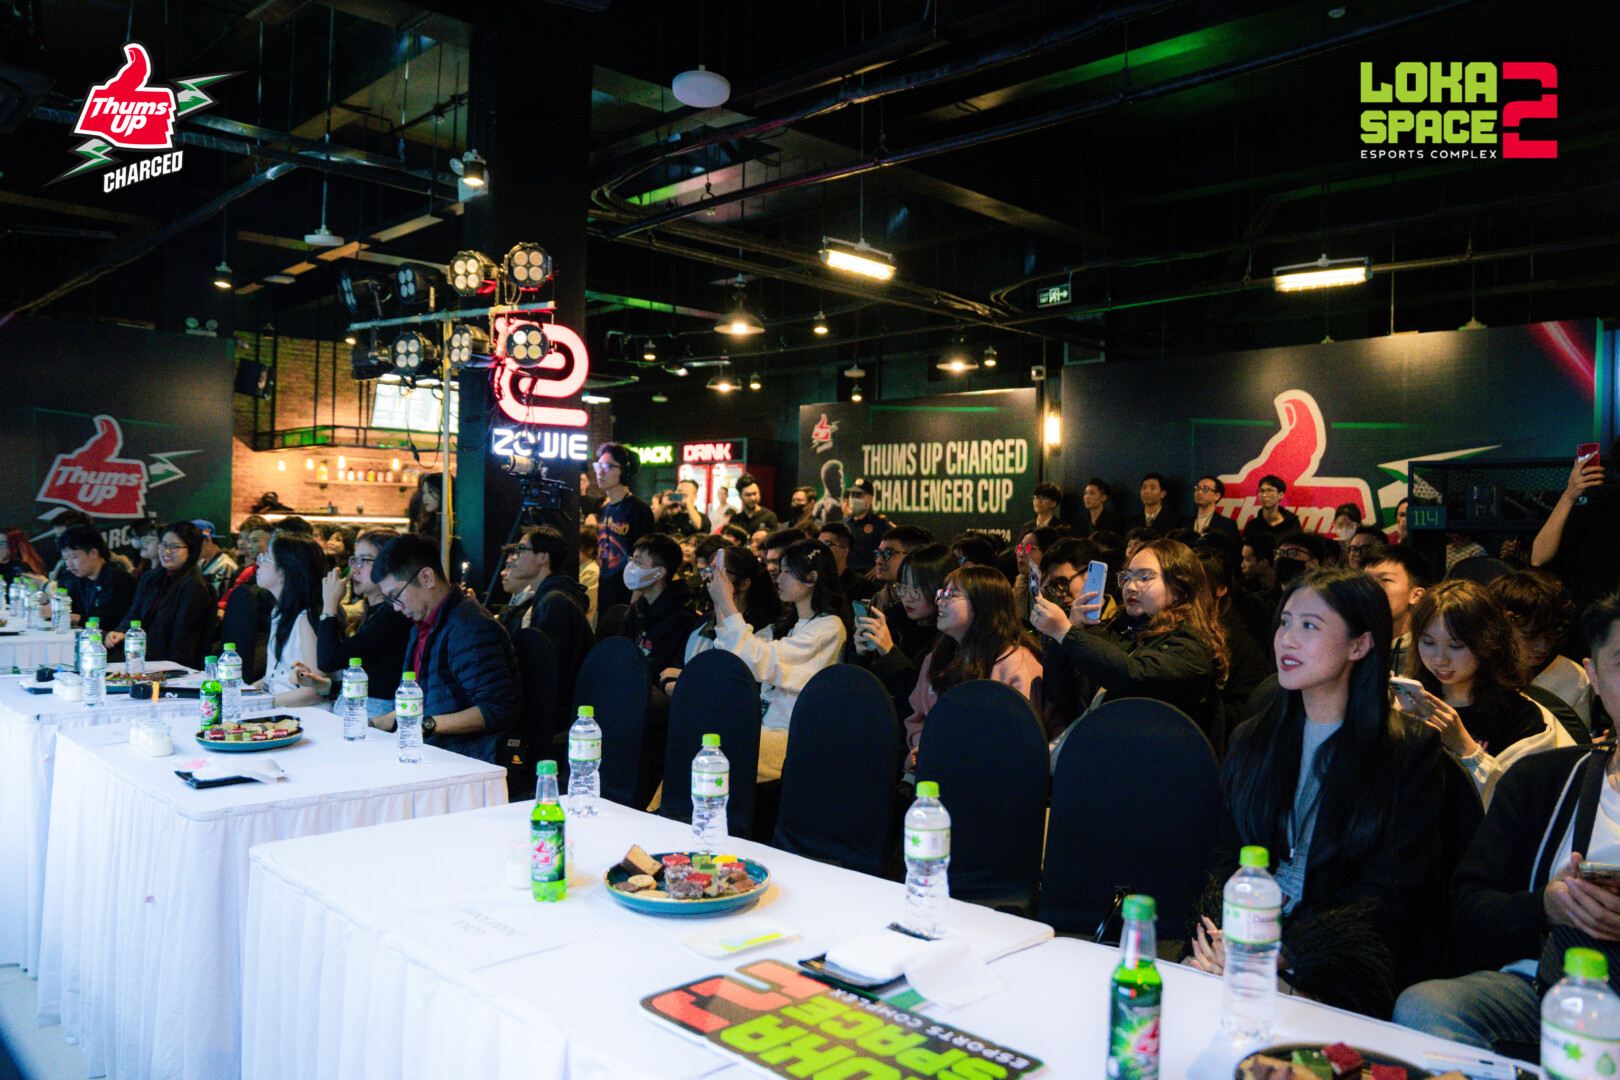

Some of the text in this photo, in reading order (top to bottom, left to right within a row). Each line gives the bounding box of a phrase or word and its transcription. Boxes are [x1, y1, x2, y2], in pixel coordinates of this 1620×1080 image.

[683, 442, 732, 462] DRINK
[862, 438, 1028, 476] THUMS UP CHARGED
[55, 466, 142, 487] Thums
[872, 478, 1014, 513] CHALLENGER CUP
[1413, 510, 1438, 526] 114
[780, 995, 1009, 1080] SPACE
[829, 988, 1030, 1069] ESPORTS COMPLEX
